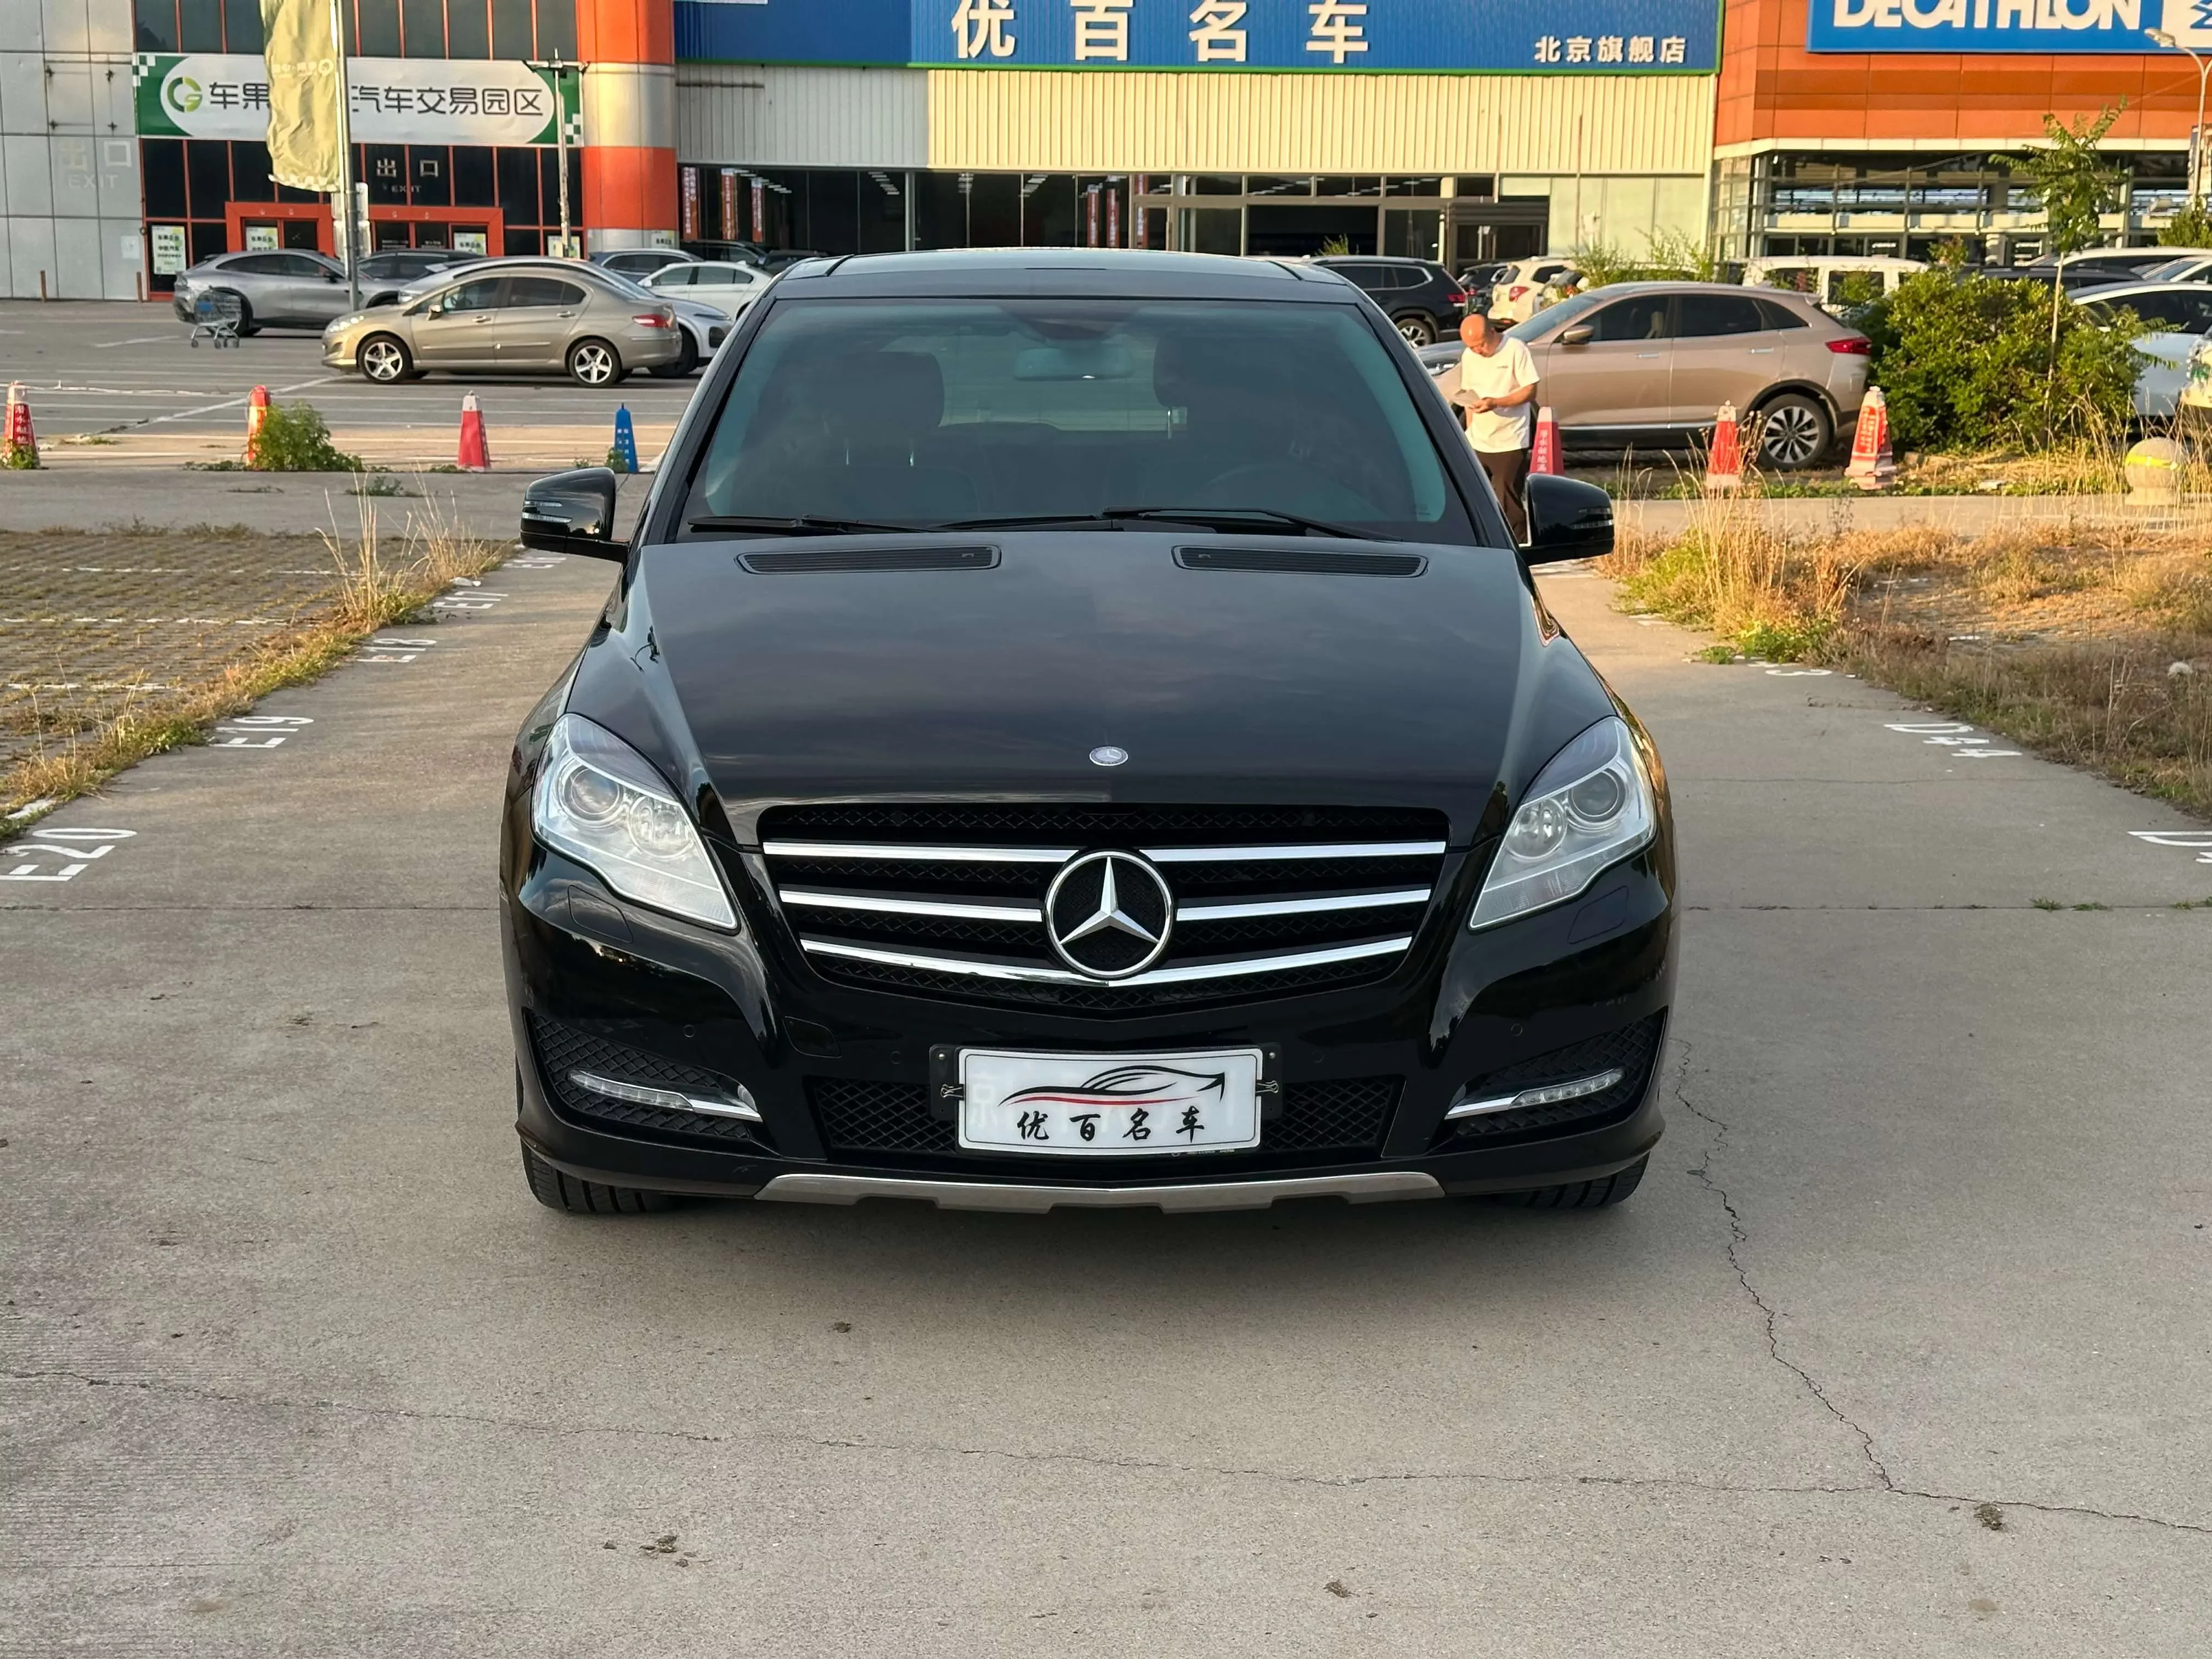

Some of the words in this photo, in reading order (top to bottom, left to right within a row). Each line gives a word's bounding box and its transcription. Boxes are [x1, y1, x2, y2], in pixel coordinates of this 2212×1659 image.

[951, 0, 1369, 64] 优百名车
[1534, 35, 1687, 64] 北京旗舰店
[68, 174, 119, 188] EXIT
[376, 158, 439, 178] 出口
[209, 715, 314, 748] E19
[0, 827, 138, 882] E20
[1017, 1105, 1205, 1143] 优百名车
